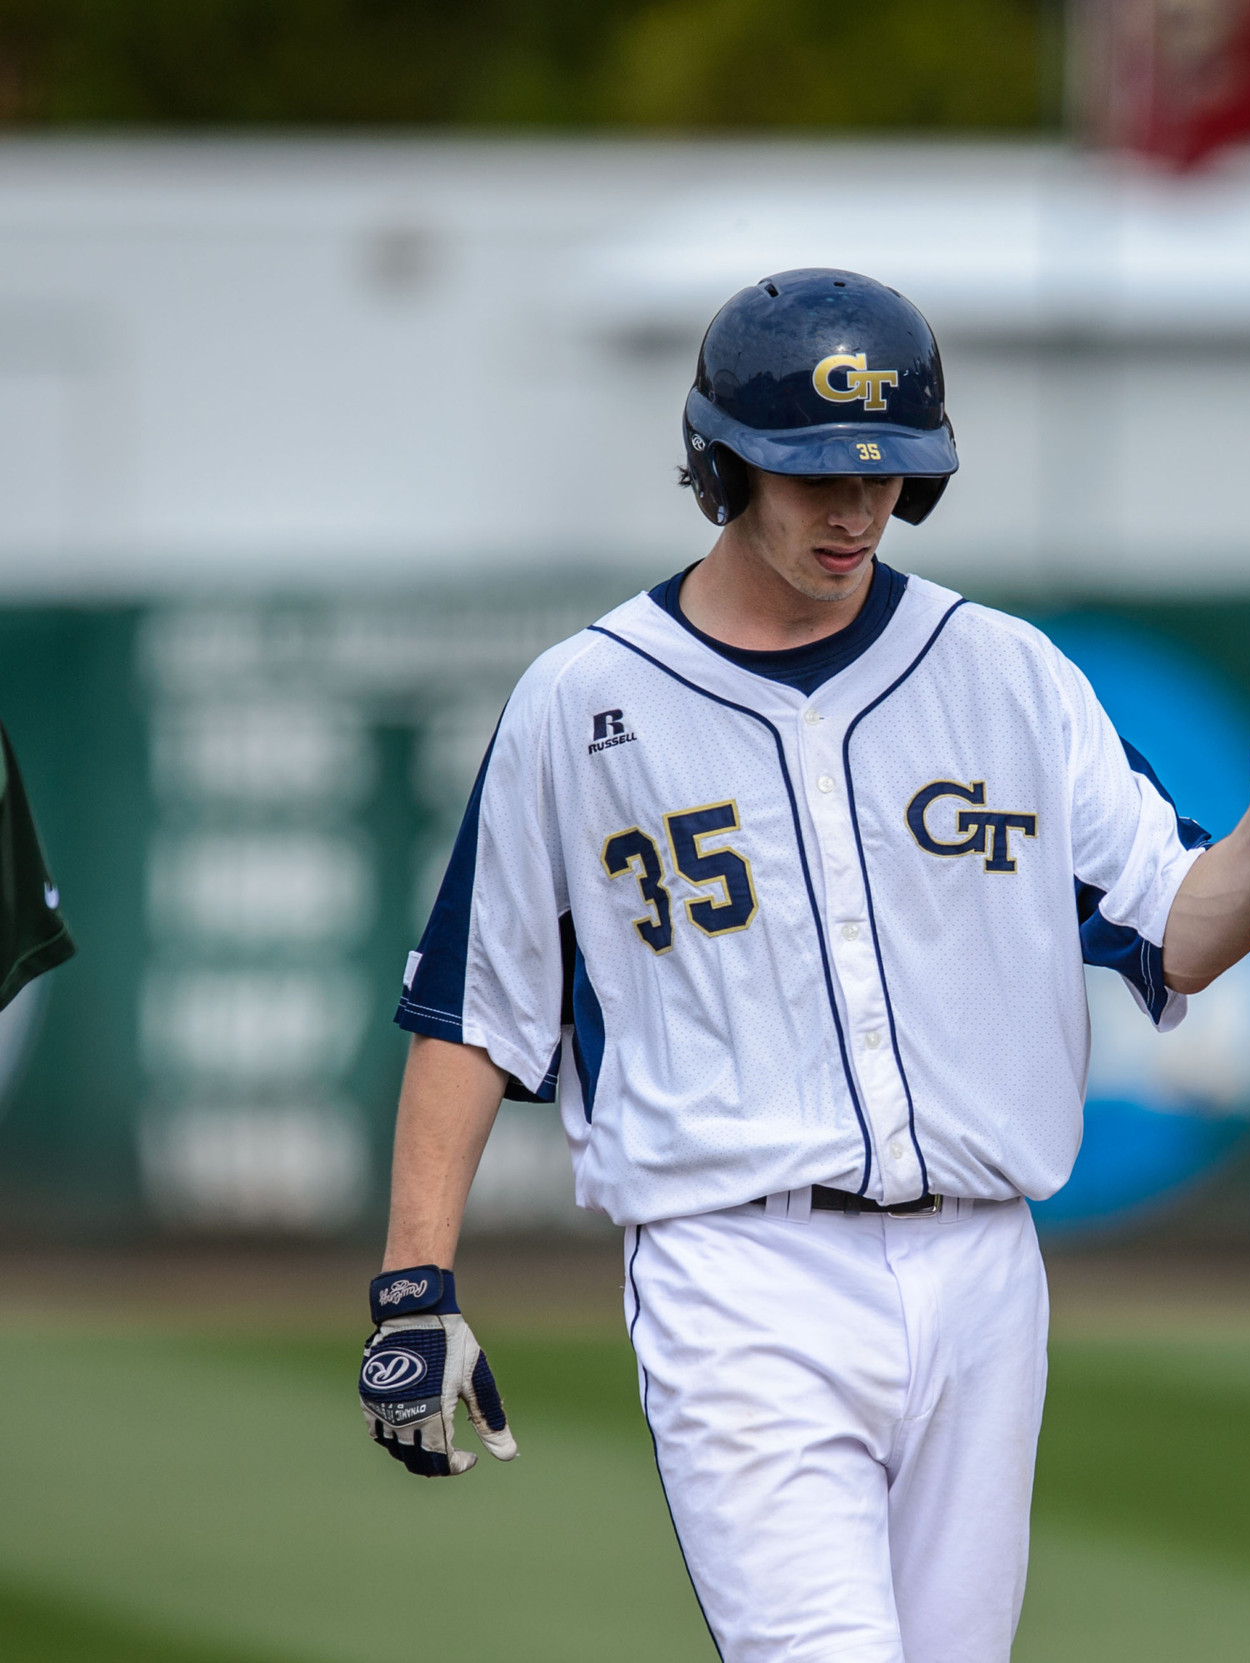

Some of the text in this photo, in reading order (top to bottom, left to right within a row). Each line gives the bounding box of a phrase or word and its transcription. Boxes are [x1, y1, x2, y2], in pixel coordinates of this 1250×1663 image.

[812, 353, 898, 411] GT
[856, 443, 881, 460] 35
[593, 709, 624, 741] R
[588, 732, 637, 755] RUSSELL
[905, 779, 1037, 874] GT
[602, 799, 758, 955] 35
[395, 1404, 427, 1422] DYNAMIC
